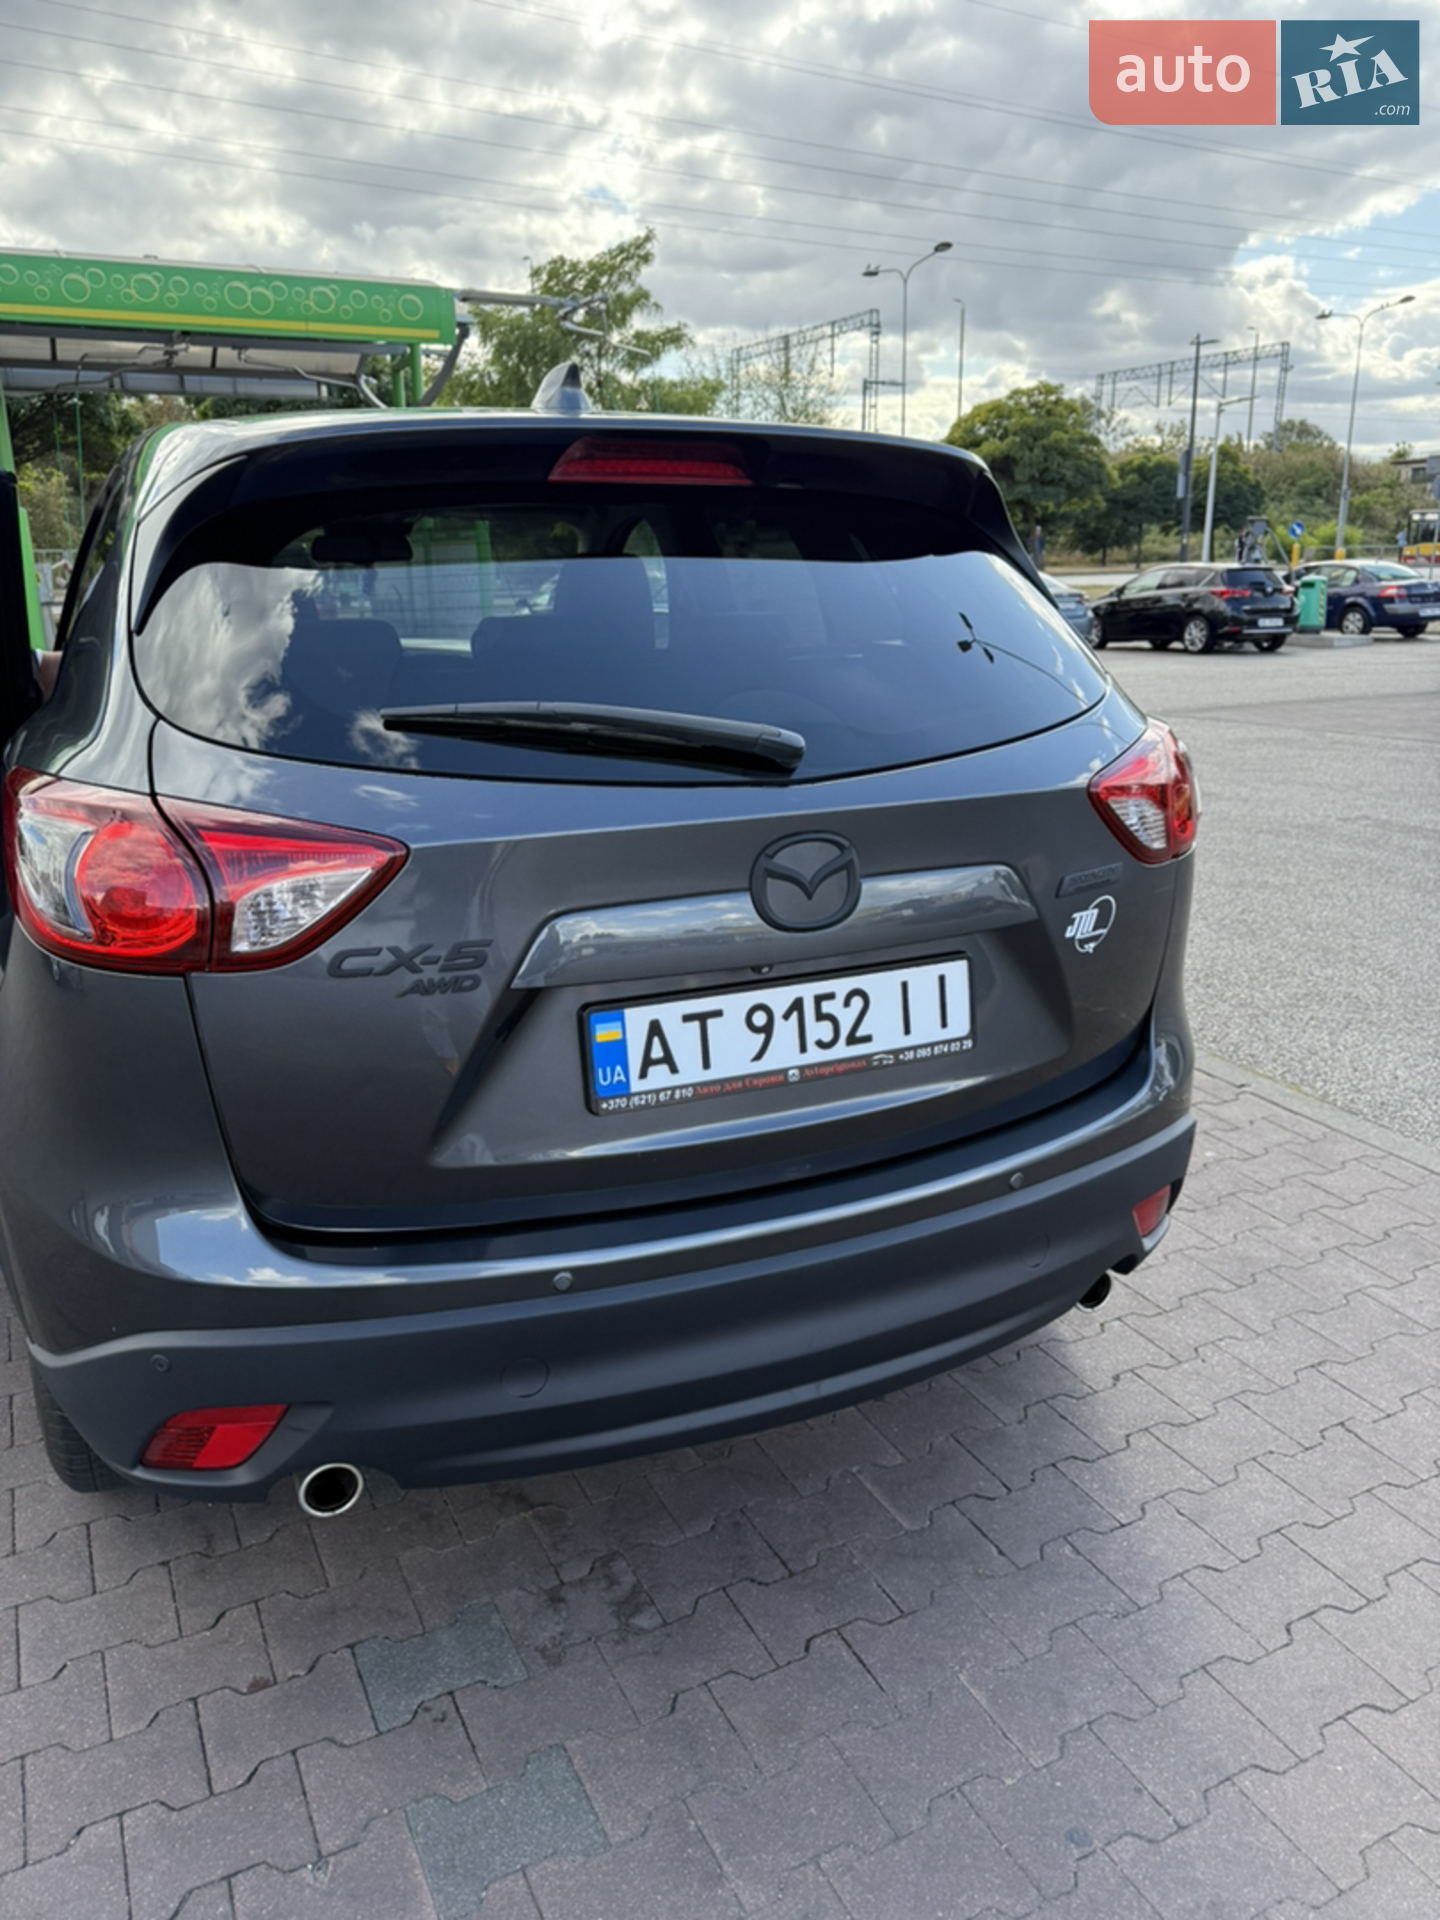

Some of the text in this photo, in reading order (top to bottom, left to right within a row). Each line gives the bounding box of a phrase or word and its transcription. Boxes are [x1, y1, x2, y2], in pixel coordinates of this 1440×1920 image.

[326, 939, 494, 979] CX-5
[396, 974, 482, 998] AWD
[638, 1009, 724, 1080] AT
[744, 988, 874, 1063] 9152
[598, 1065, 627, 1086] UA
[601, 1097, 628, 1110] +370
[659, 1089, 672, 1102] 67
[673, 1086, 694, 1099] 810
